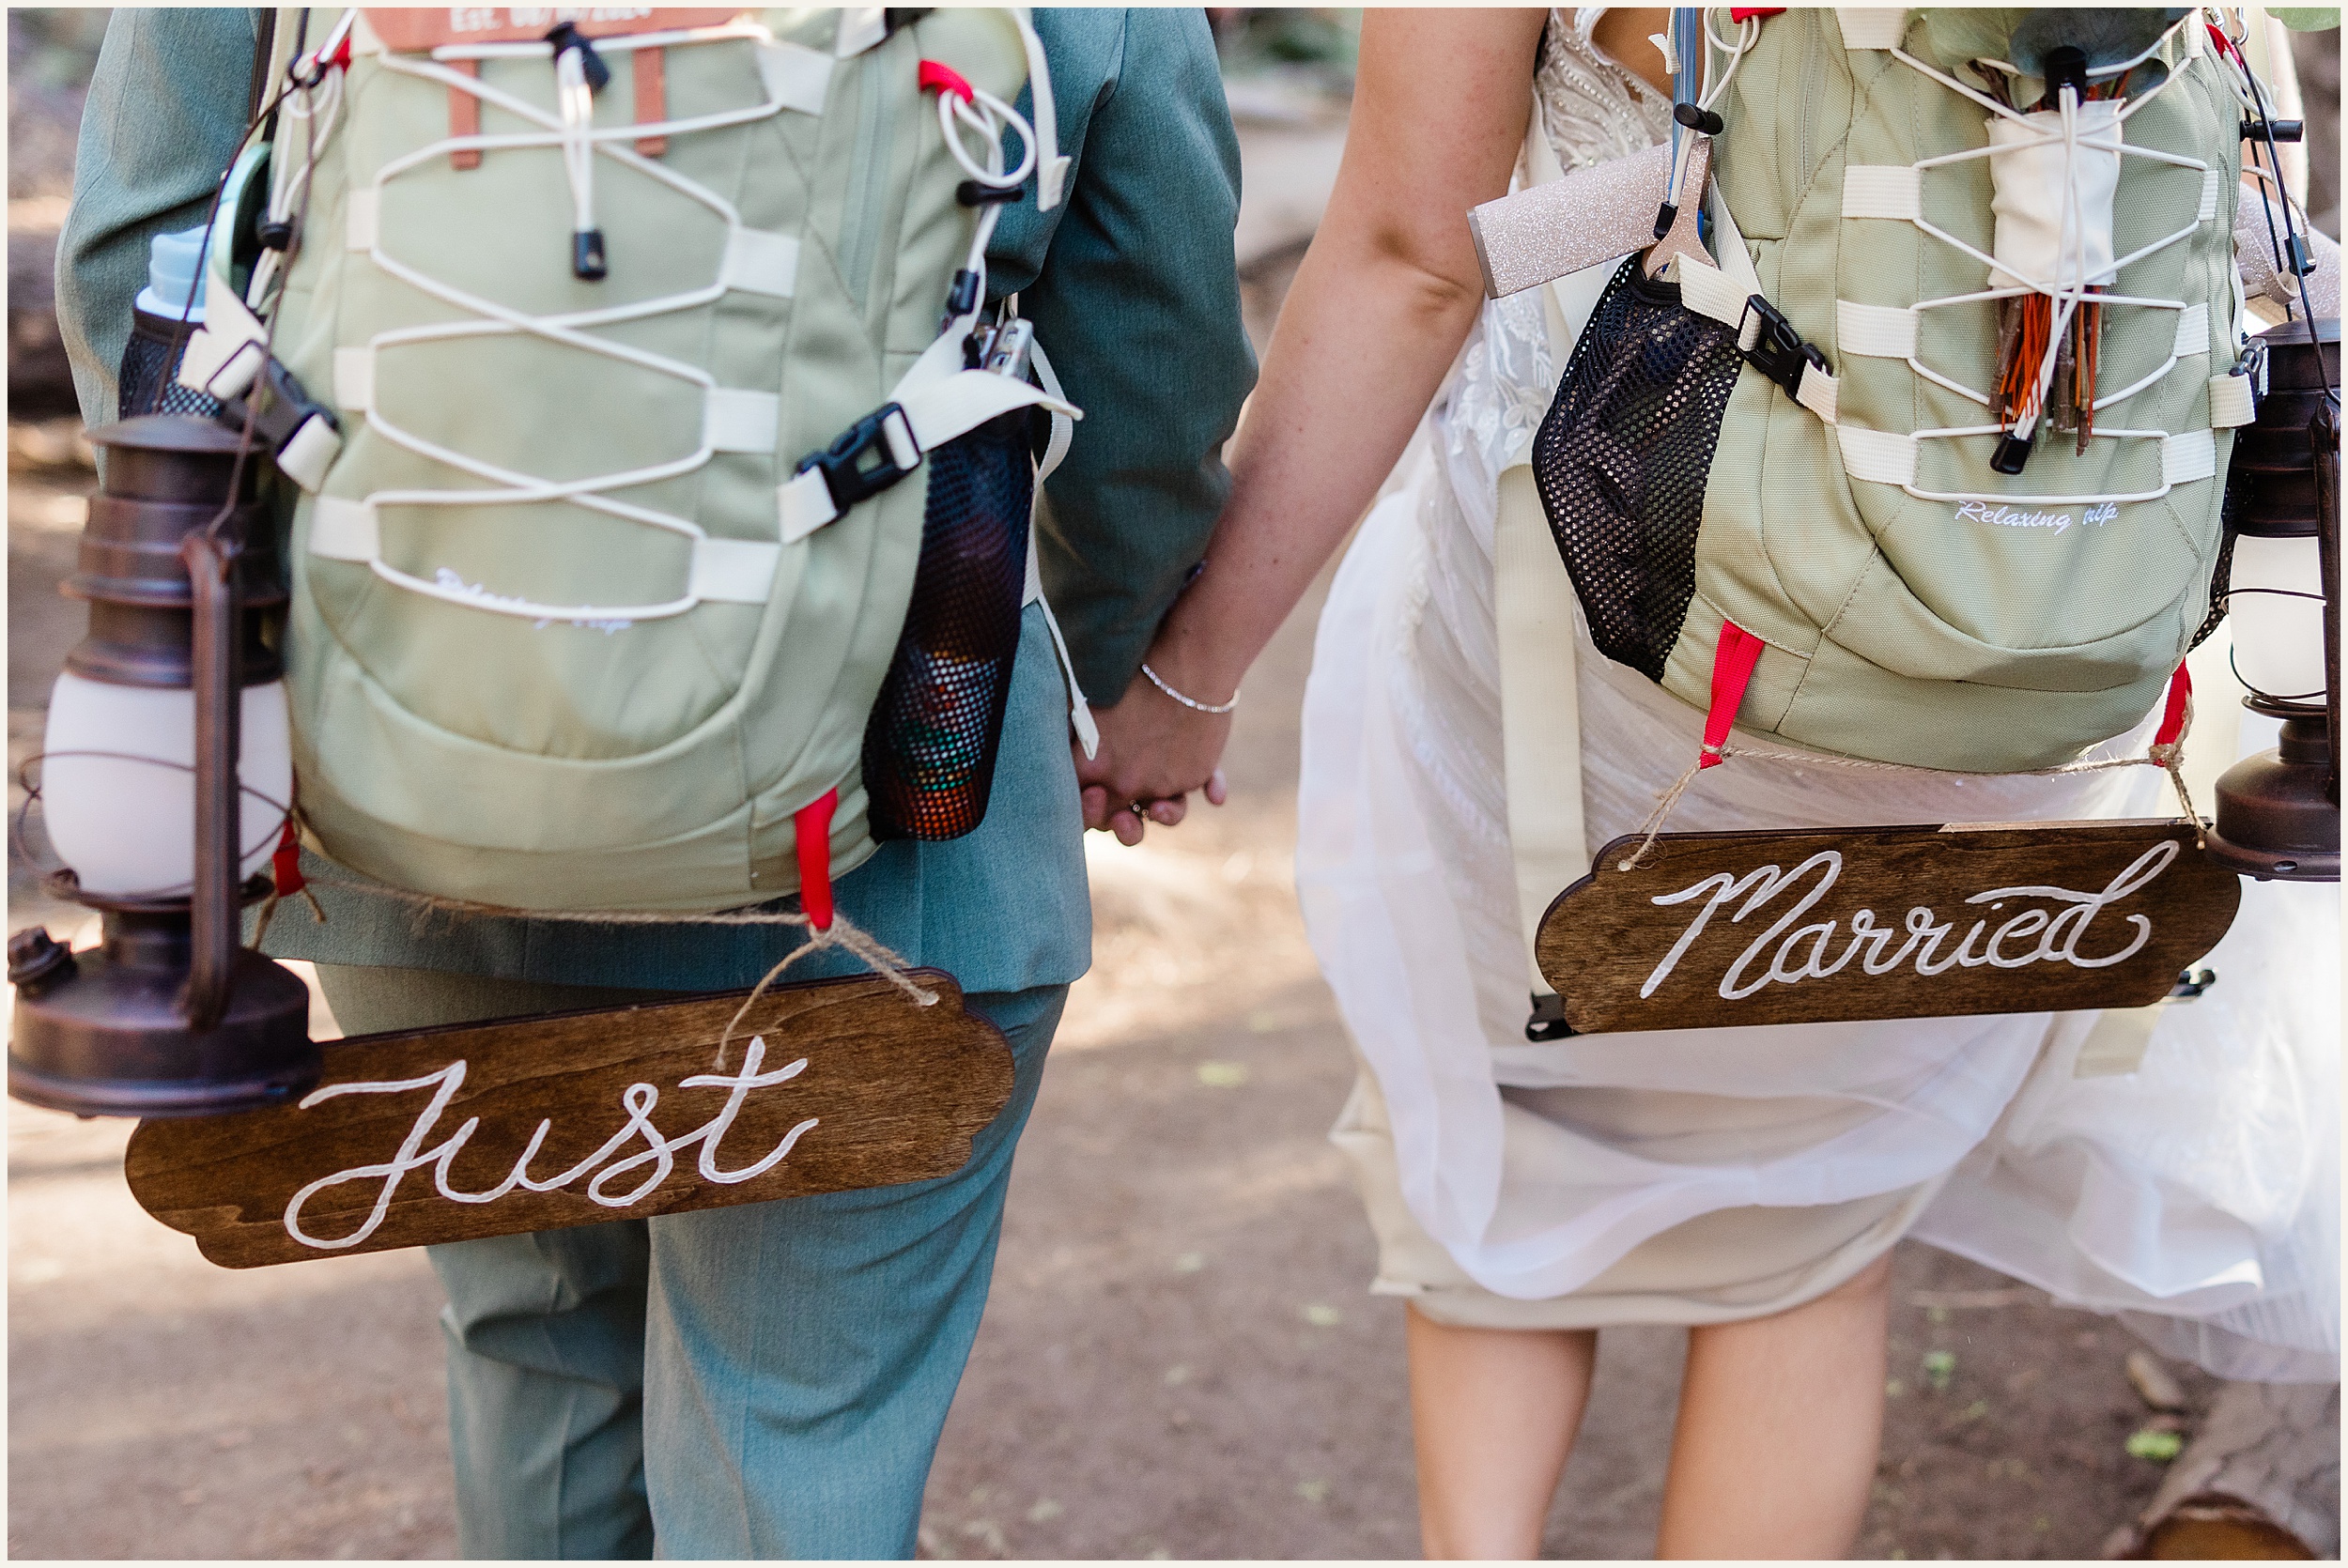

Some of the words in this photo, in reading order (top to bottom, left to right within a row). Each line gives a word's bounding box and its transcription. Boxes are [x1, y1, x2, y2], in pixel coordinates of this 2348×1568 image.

[1954, 500, 2073, 536] Relaxing
[1640, 840, 2179, 1000] Married
[284, 1035, 820, 1250] Just
